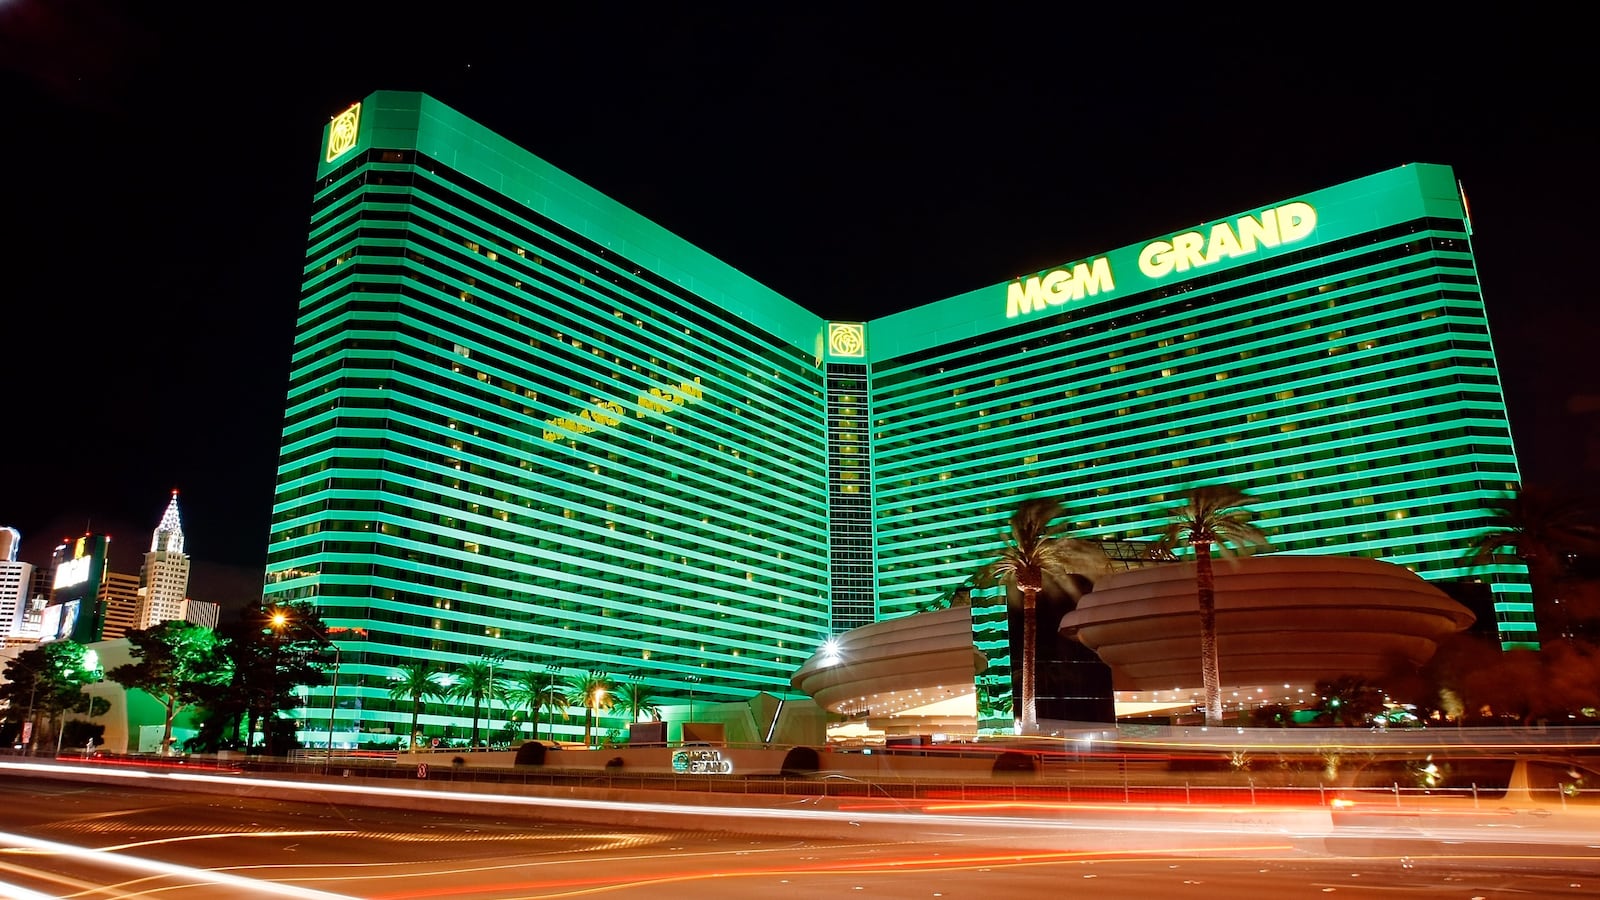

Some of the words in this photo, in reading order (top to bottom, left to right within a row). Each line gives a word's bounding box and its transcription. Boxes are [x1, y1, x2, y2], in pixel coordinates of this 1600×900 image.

[1006, 257, 1115, 318] MGM
[1138, 202, 1317, 278] GRAND
[690, 761, 730, 773] GRAND
